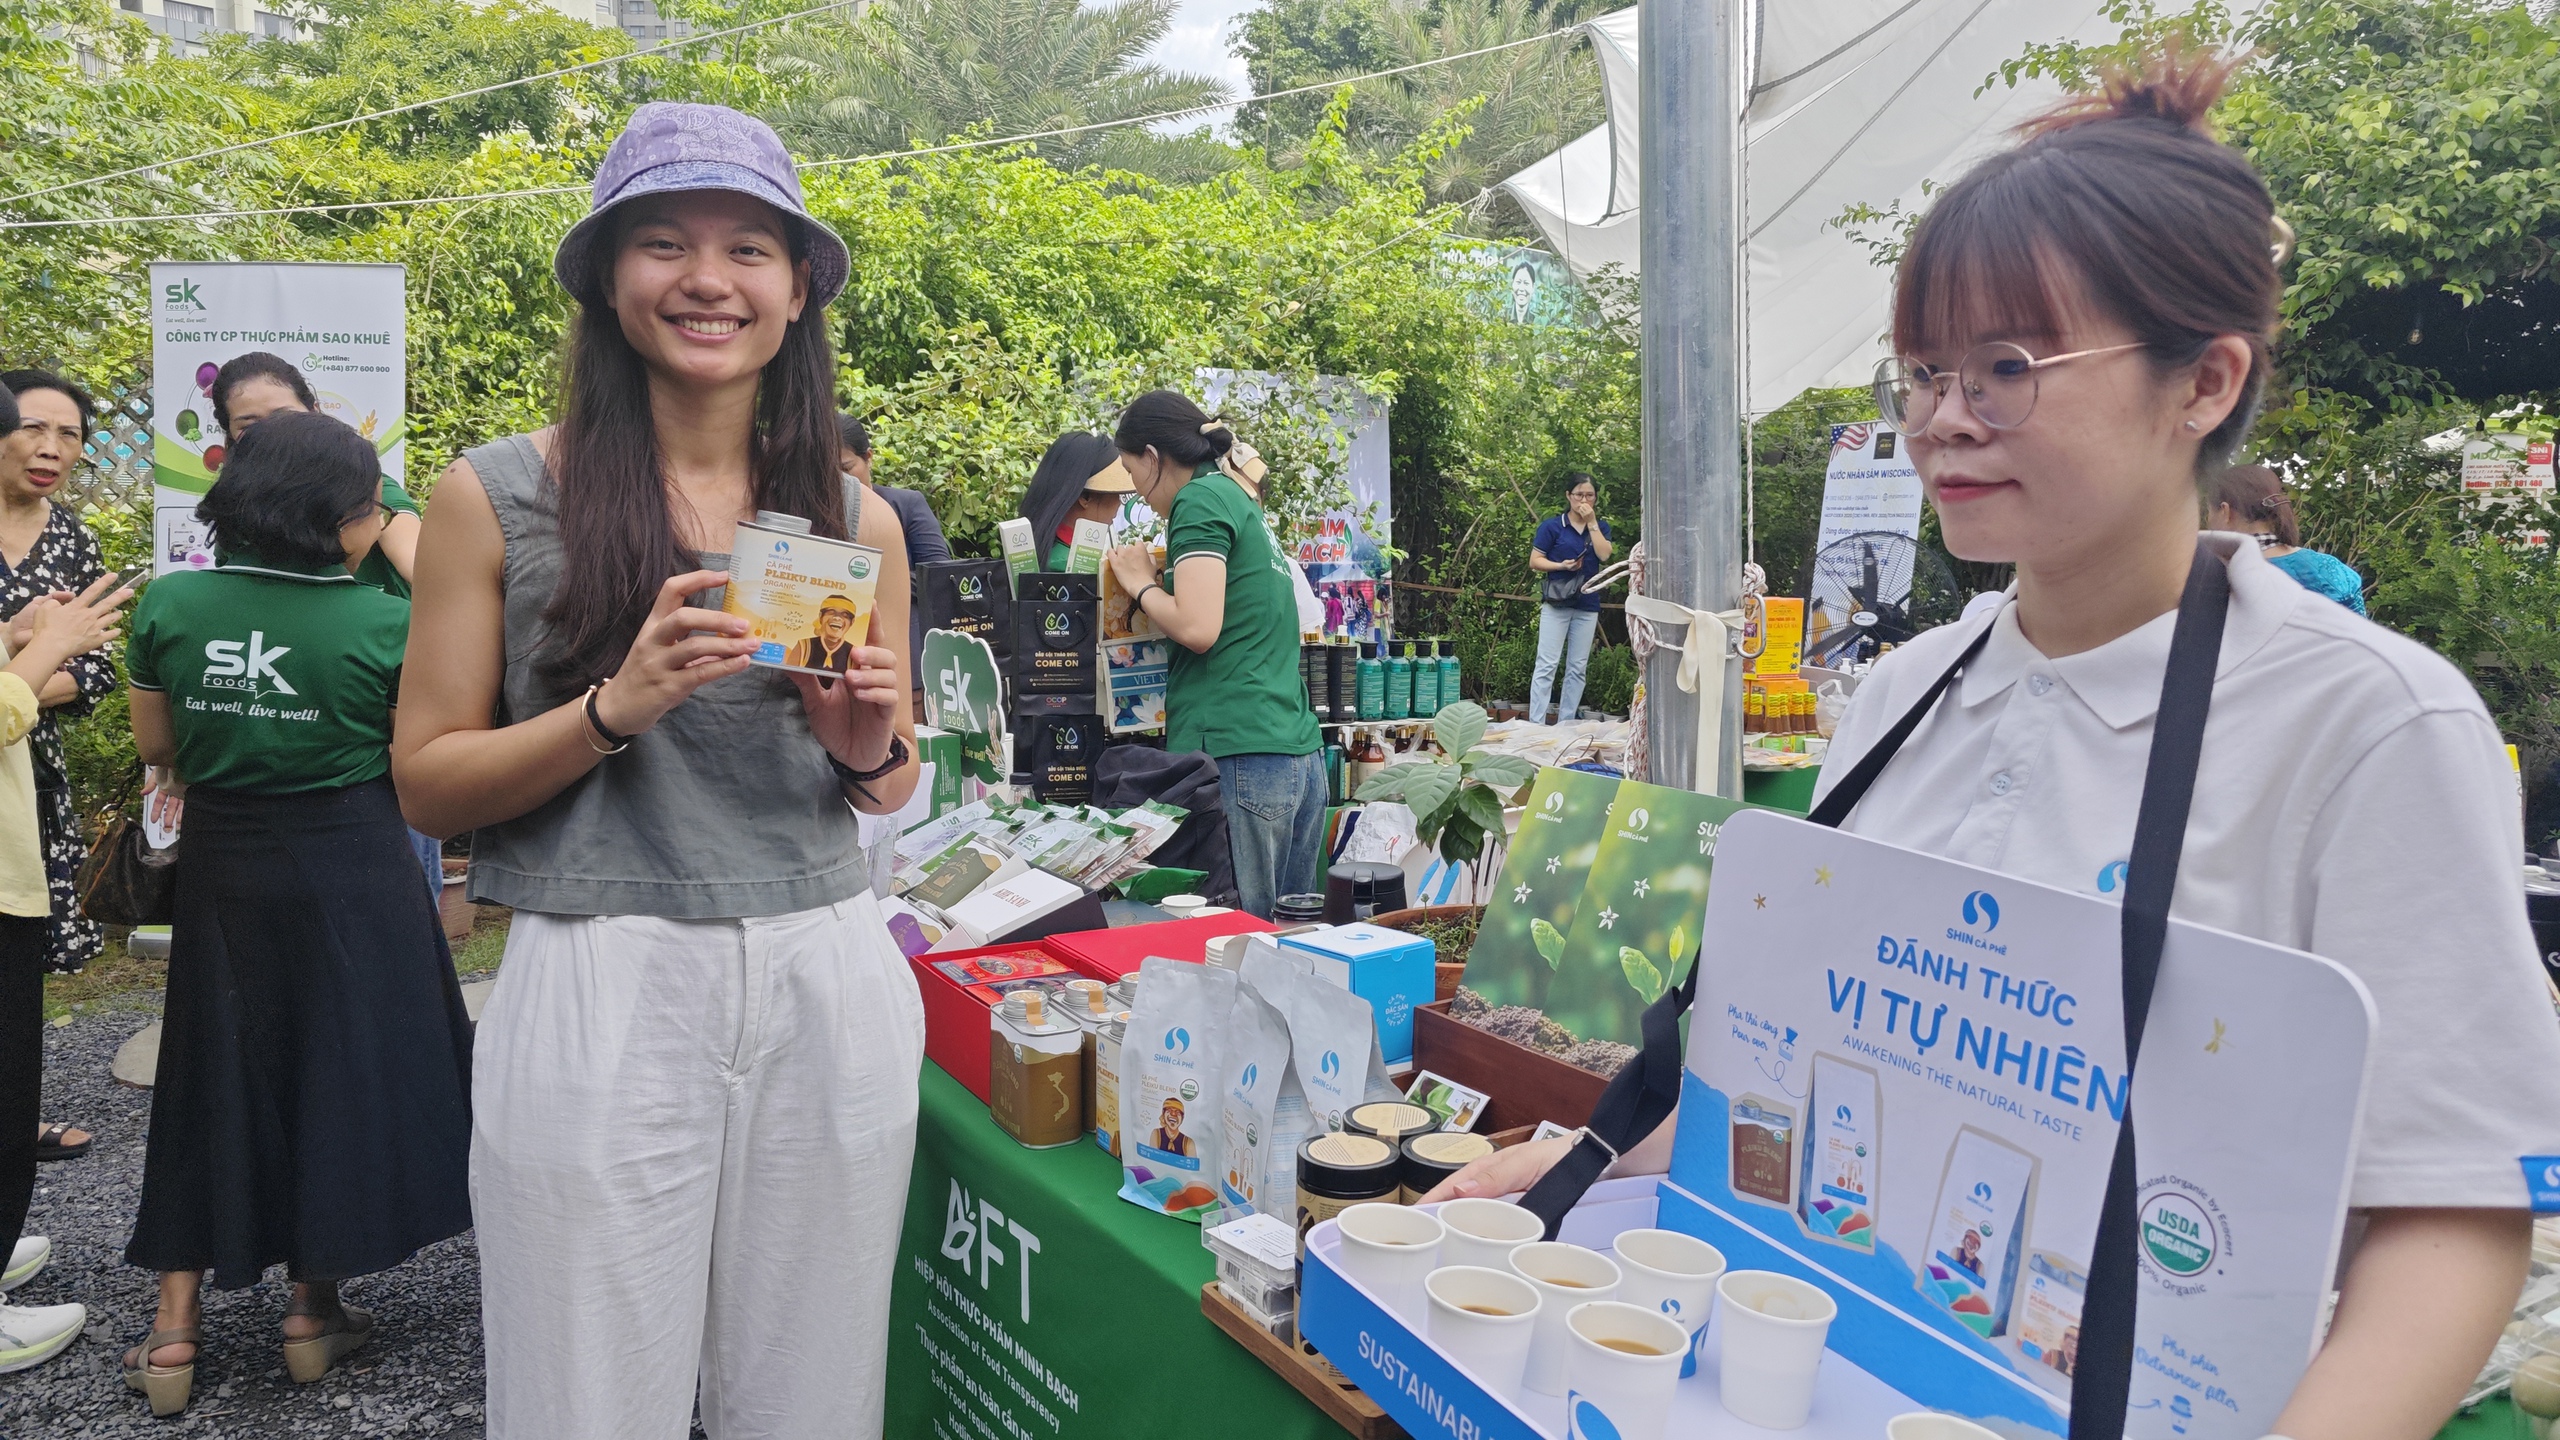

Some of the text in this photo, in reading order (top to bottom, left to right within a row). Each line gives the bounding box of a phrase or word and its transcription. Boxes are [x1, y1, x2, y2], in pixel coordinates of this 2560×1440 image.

[166, 326, 391, 345] CÔNG TY CP THỰC PHẨM SAO KHUÊ
[322, 354, 350, 363] Hotline:
[322, 365, 390, 374] (+84) 877 600 900
[1846, 469, 1866, 480] NHÂN
[2465, 480, 2493, 488] Hotline:
[763, 578, 796, 590] ORGANIC
[764, 568, 847, 591] PLEIKU BLEND
[952, 622, 995, 633] COME ON
[1035, 659, 1079, 668] COME ON
[185, 696, 320, 722] Eat well, live well!
[1048, 773, 1087, 782] COME ON
[1535, 811, 1549, 822] SHIN
[1617, 829, 1632, 840] SHIN
[1946, 928, 2008, 956] SHIN CÀ PHÊ
[1877, 935, 2077, 1026] ĐÁNH THỨC
[1728, 1003, 1743, 1021] Pha
[1826, 968, 2129, 1122] VỊ TỰ NHIÊN
[1153, 1053, 1195, 1069] SHIN CÀ PHÊ
[1142, 1081, 1177, 1093] PLEIKU BLEND
[1311, 1075, 1342, 1096] SHIN CÀ PHÊ
[1842, 1034, 2082, 1142] AWAKENING THE NATURAL TASTE
[2169, 1174, 2208, 1200] Organic
[2207, 1198, 2220, 1213] by
[2158, 1207, 2200, 1240] USDA
[2147, 1228, 2204, 1263] ORGANIC
[2162, 1279, 2207, 1297] Organic
[914, 1254, 1079, 1415] HIỆP HỘI THỰC PHẨM MINH BẠCH
[2162, 1333, 2219, 1376] Pha phin
[927, 1298, 1060, 1435] Association of Food Transparency
[940, 1353, 965, 1385] phẩm
[965, 1374, 978, 1398] an
[978, 1384, 1001, 1420] toàn
[2135, 1345, 2239, 1413] Vietnamese filter
[931, 1368, 948, 1395] Safe
[948, 1385, 967, 1415] Food
